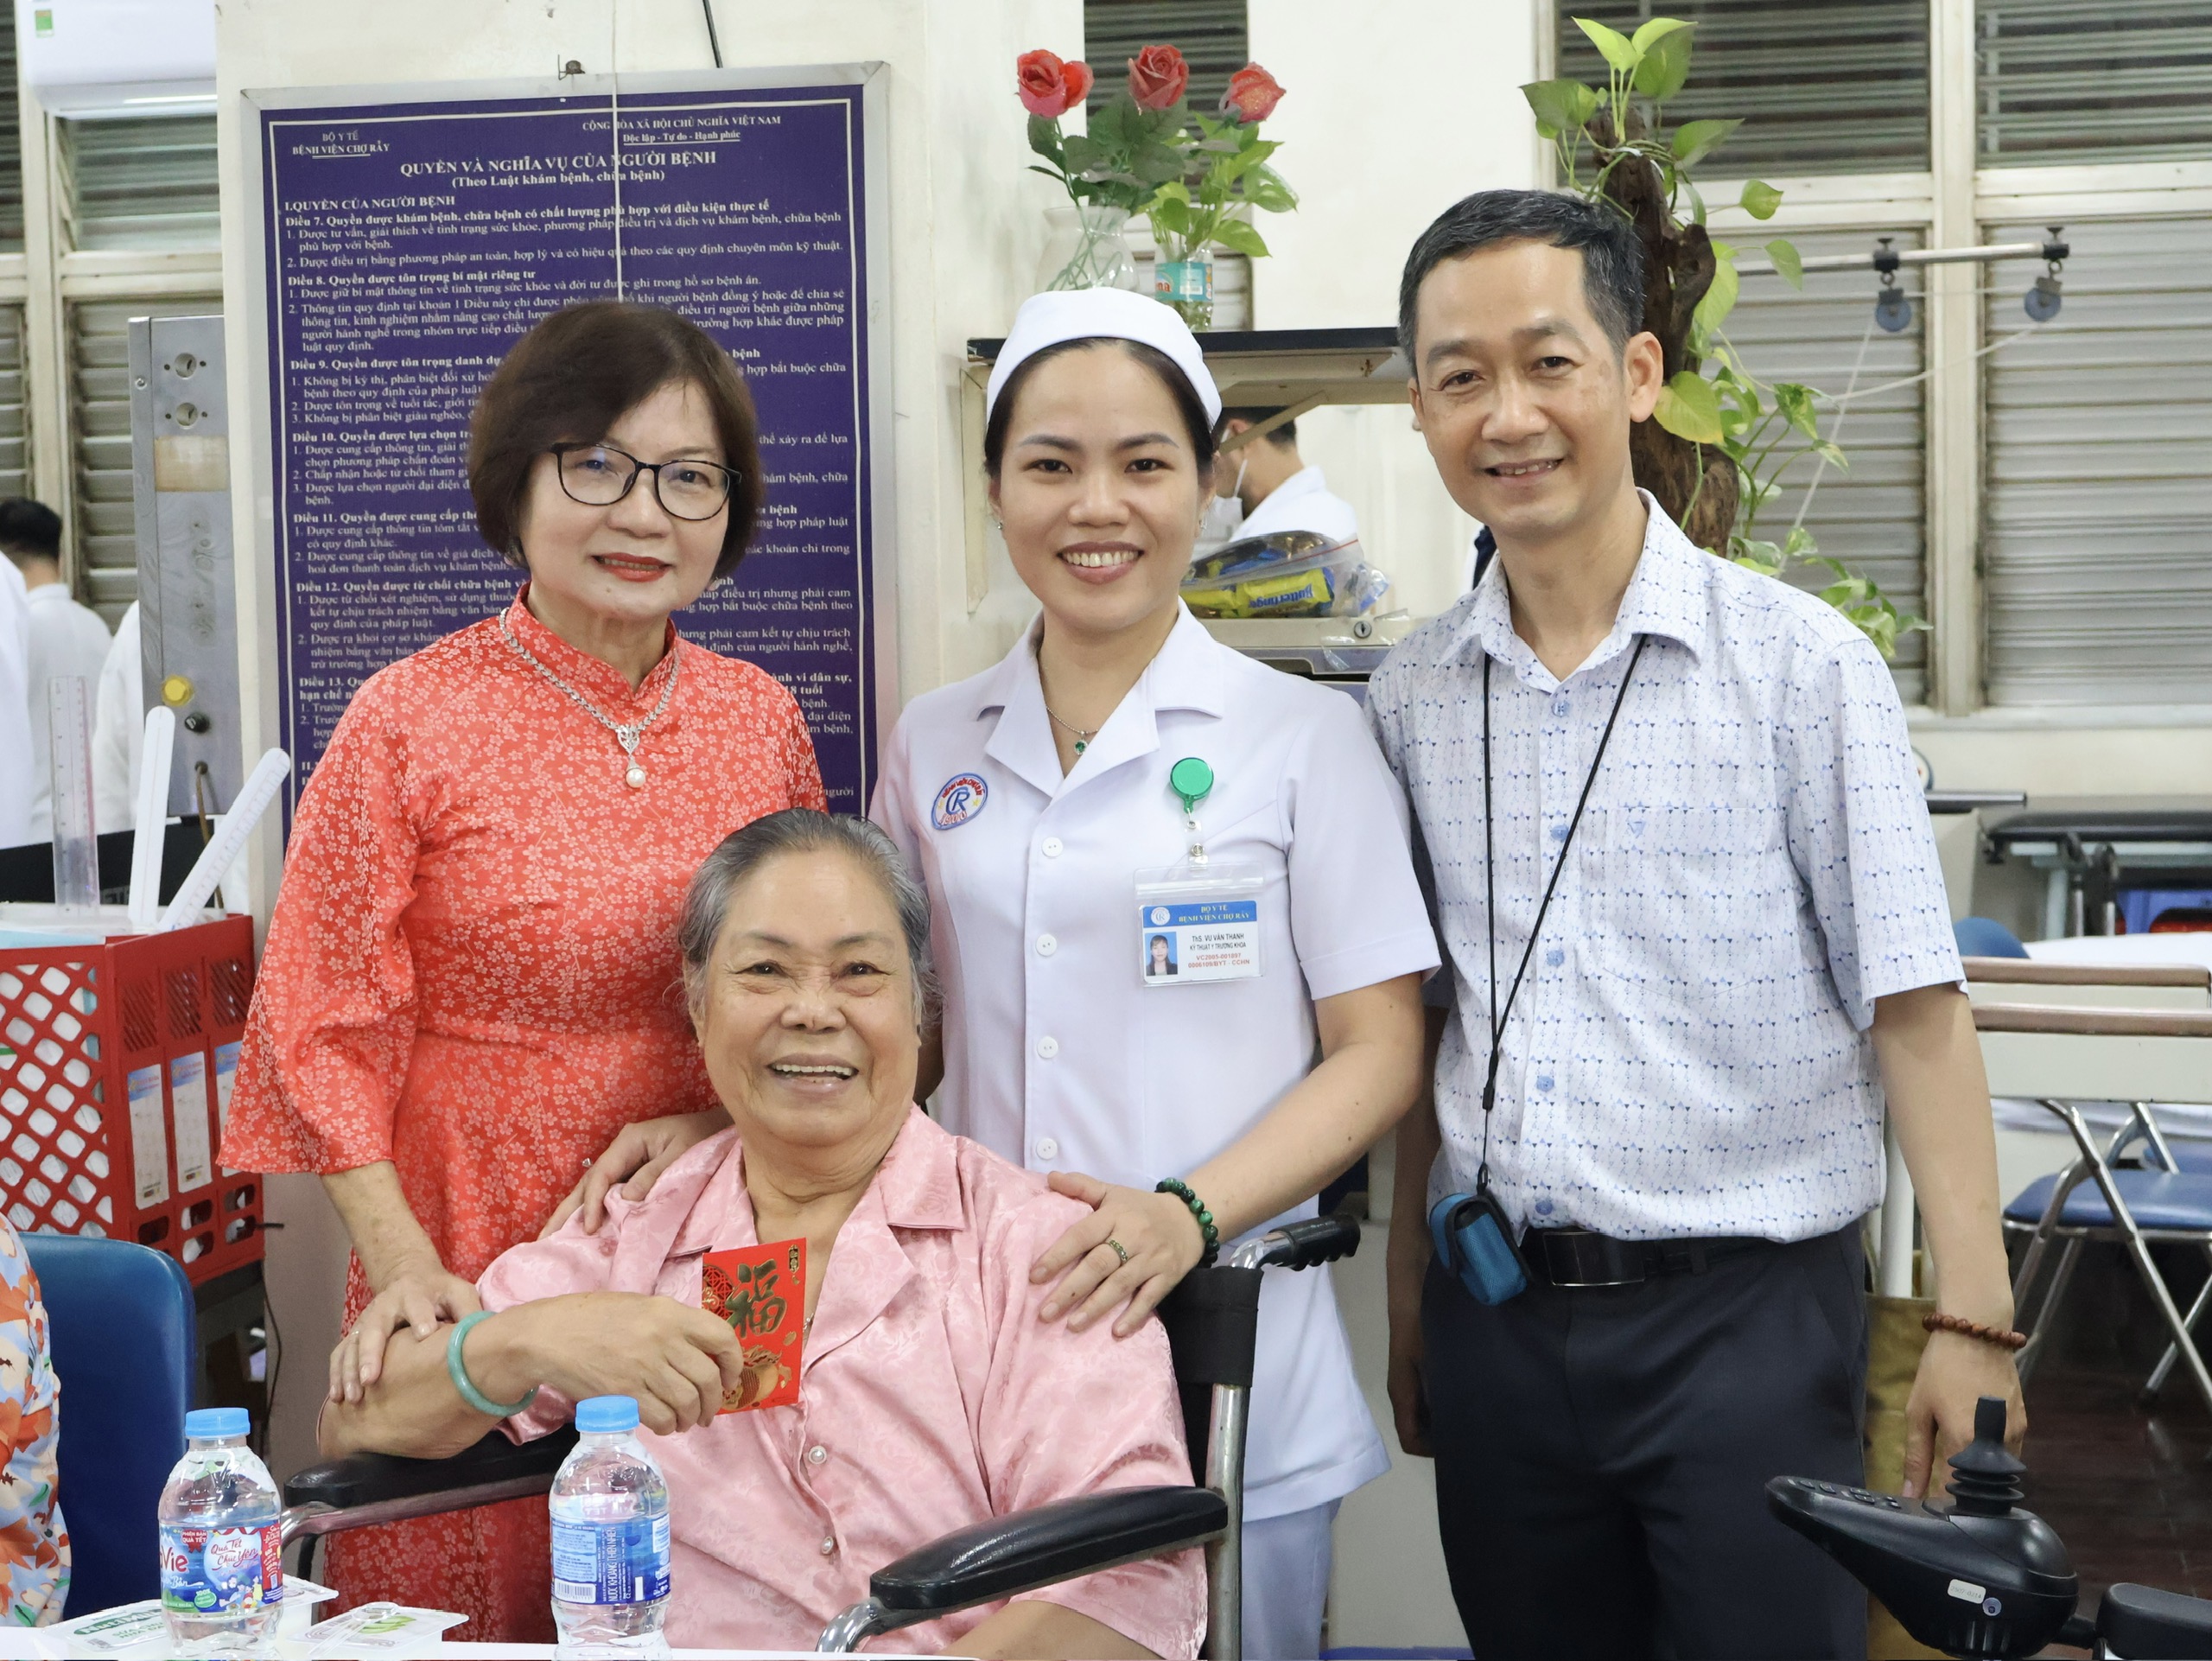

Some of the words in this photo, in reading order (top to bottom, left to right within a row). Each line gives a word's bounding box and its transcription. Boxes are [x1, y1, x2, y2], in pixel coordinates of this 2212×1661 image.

[582, 120, 610, 133] CỘNG
[636, 118, 650, 129] XÃ
[652, 118, 671, 130] HỘI
[672, 117, 694, 127] CHỦ
[696, 115, 729, 126] NGHĨA
[732, 114, 755, 127] VIỆT
[757, 115, 780, 124] NAM
[321, 131, 336, 143] BỘ
[346, 130, 359, 141] TẾ
[292, 145, 319, 156] BỆNH
[321, 144, 345, 156] VIỆN
[346, 144, 367, 154] CHỢ
[399, 158, 456, 176] QUYỀN
[462, 158, 484, 172] VÀ
[488, 156, 542, 171] NGHĨA
[546, 158, 568, 172] VỤ
[571, 154, 607, 168] CỦA
[671, 150, 715, 167] BỆNH
[451, 176, 487, 189] (Theo
[490, 175, 518, 188] Luật
[522, 174, 556, 184] khám
[560, 173, 594, 185] bệnh,
[630, 170, 664, 182] bệnh)
[725, 1258, 787, 1340] 福
